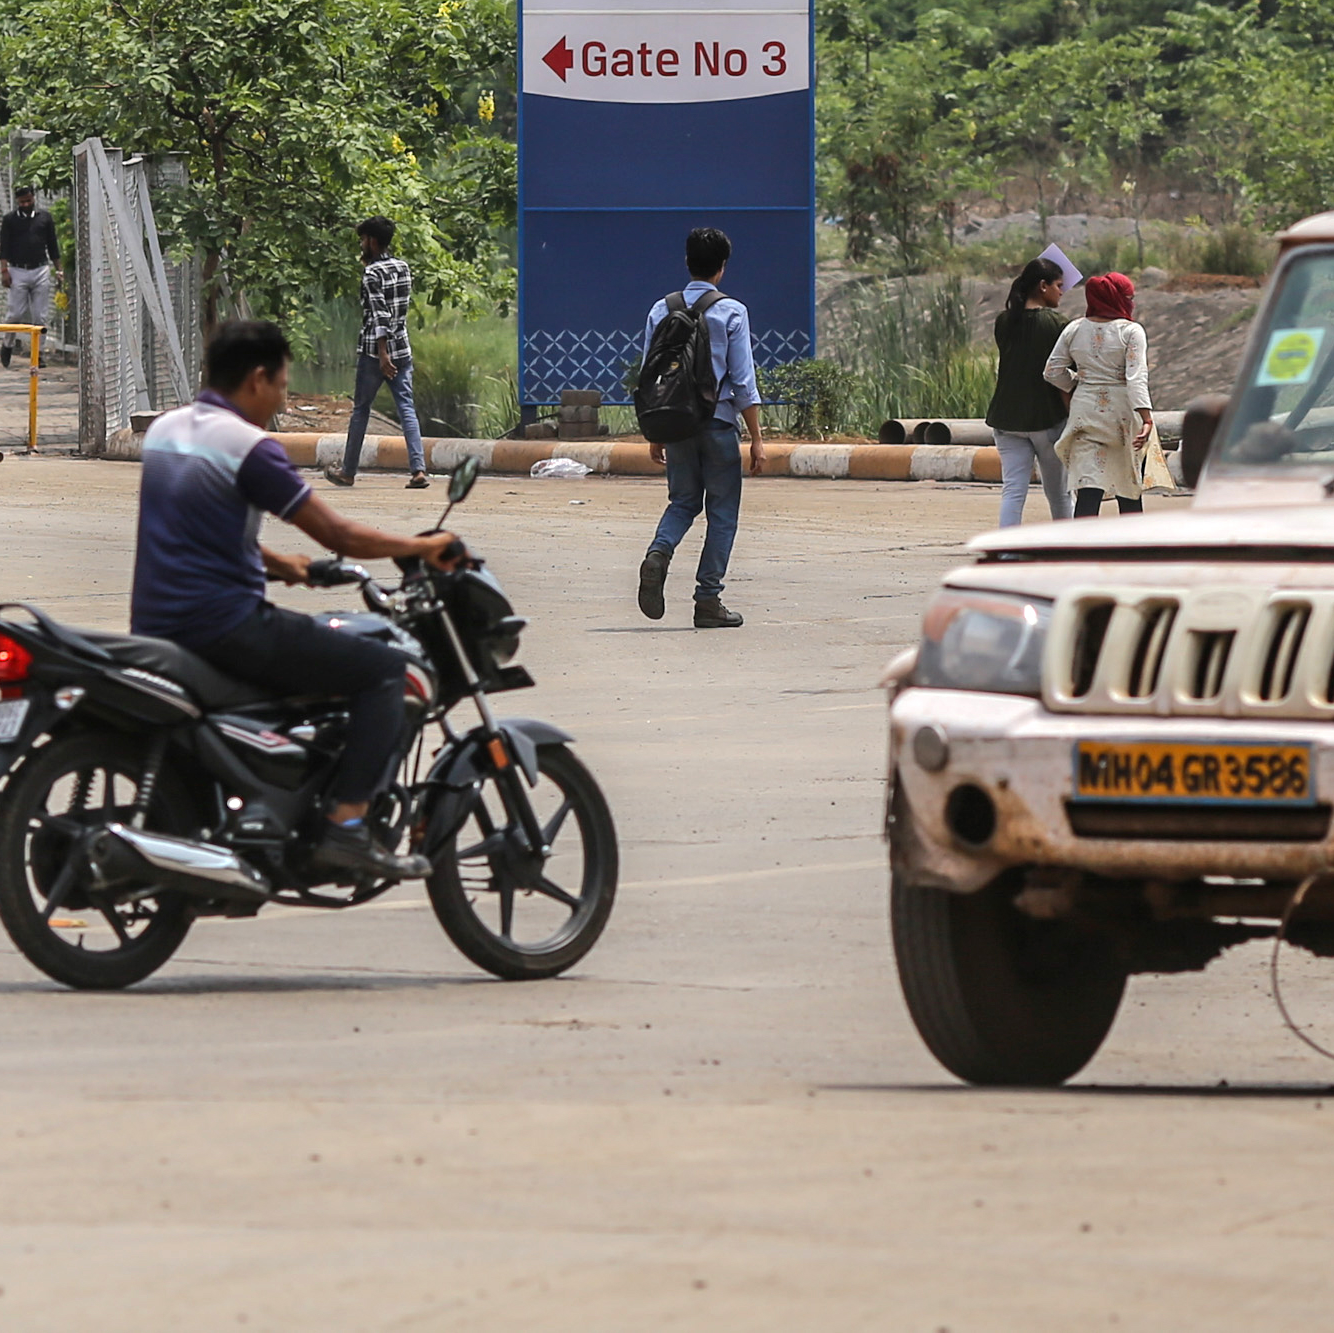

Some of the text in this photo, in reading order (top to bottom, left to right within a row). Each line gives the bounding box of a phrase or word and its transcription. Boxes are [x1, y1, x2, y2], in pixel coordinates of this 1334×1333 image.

[580, 40, 788, 78] Gate No 3
